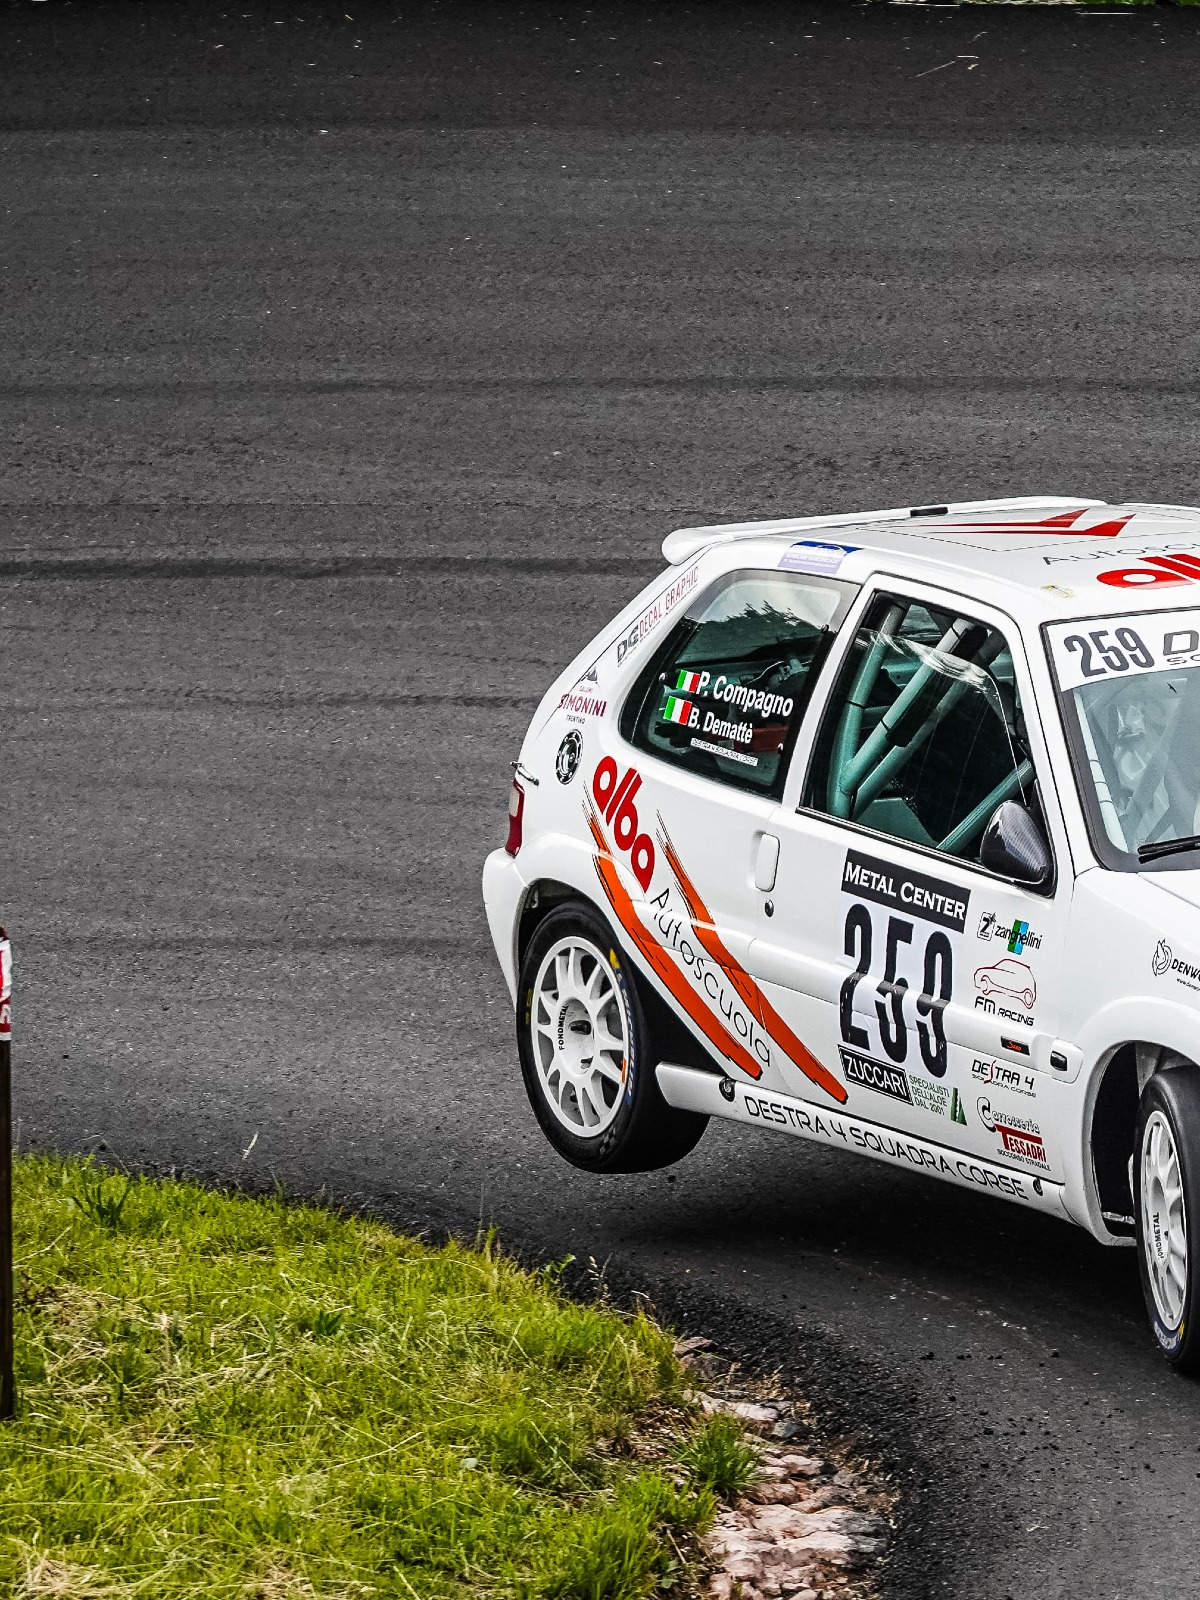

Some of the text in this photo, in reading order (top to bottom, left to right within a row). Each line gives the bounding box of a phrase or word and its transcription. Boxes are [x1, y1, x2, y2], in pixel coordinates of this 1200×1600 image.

[639, 602, 663, 638] DECAL
[665, 565, 699, 610] GRAPHIC
[1063, 626, 1155, 678] 259
[688, 706, 701, 730] B.
[696, 671, 794, 718] P. Compagno
[593, 756, 655, 893] alba
[844, 862, 966, 921] METAL CENTER
[994, 925, 1043, 949] zanghellini
[650, 888, 771, 1067] Autoscuola
[839, 903, 953, 1078] 259
[558, 1004, 569, 1051] FONDMETAL
[975, 996, 1035, 1026] FM RACING
[843, 1054, 907, 1097] ZUCCARI
[972, 1059, 1035, 1090] DESTRA 4
[744, 1095, 1029, 1200] DESTRA 4 SQUADRA CORSE
[994, 1123, 1047, 1162] TESSADRI
